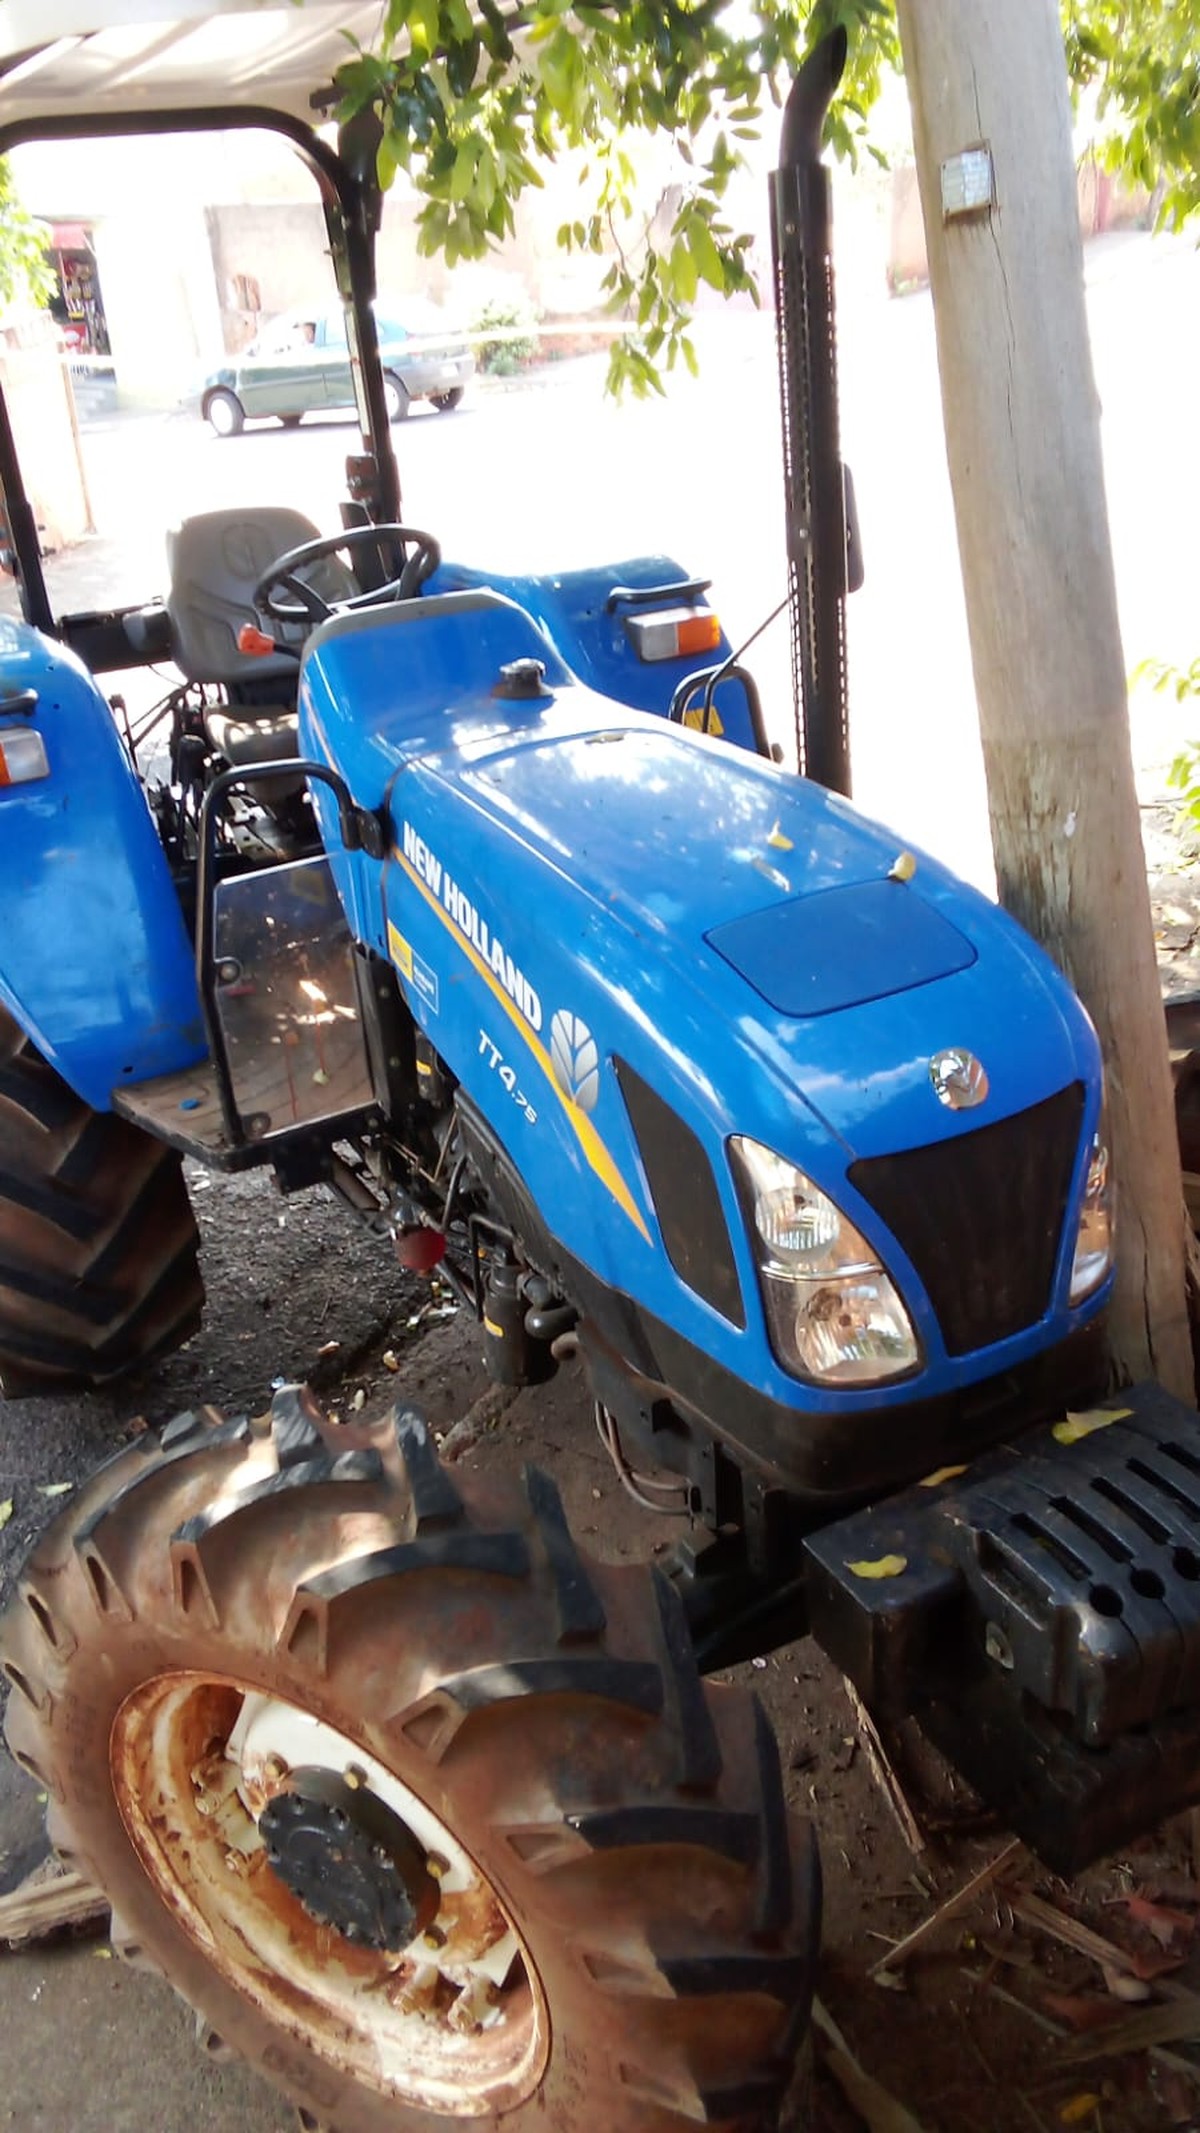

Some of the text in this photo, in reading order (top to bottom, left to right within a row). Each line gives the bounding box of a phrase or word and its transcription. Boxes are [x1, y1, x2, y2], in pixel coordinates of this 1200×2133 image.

[404, 820, 542, 1031] NEW HOLLAND
[479, 1028, 538, 1124] TT4.75
